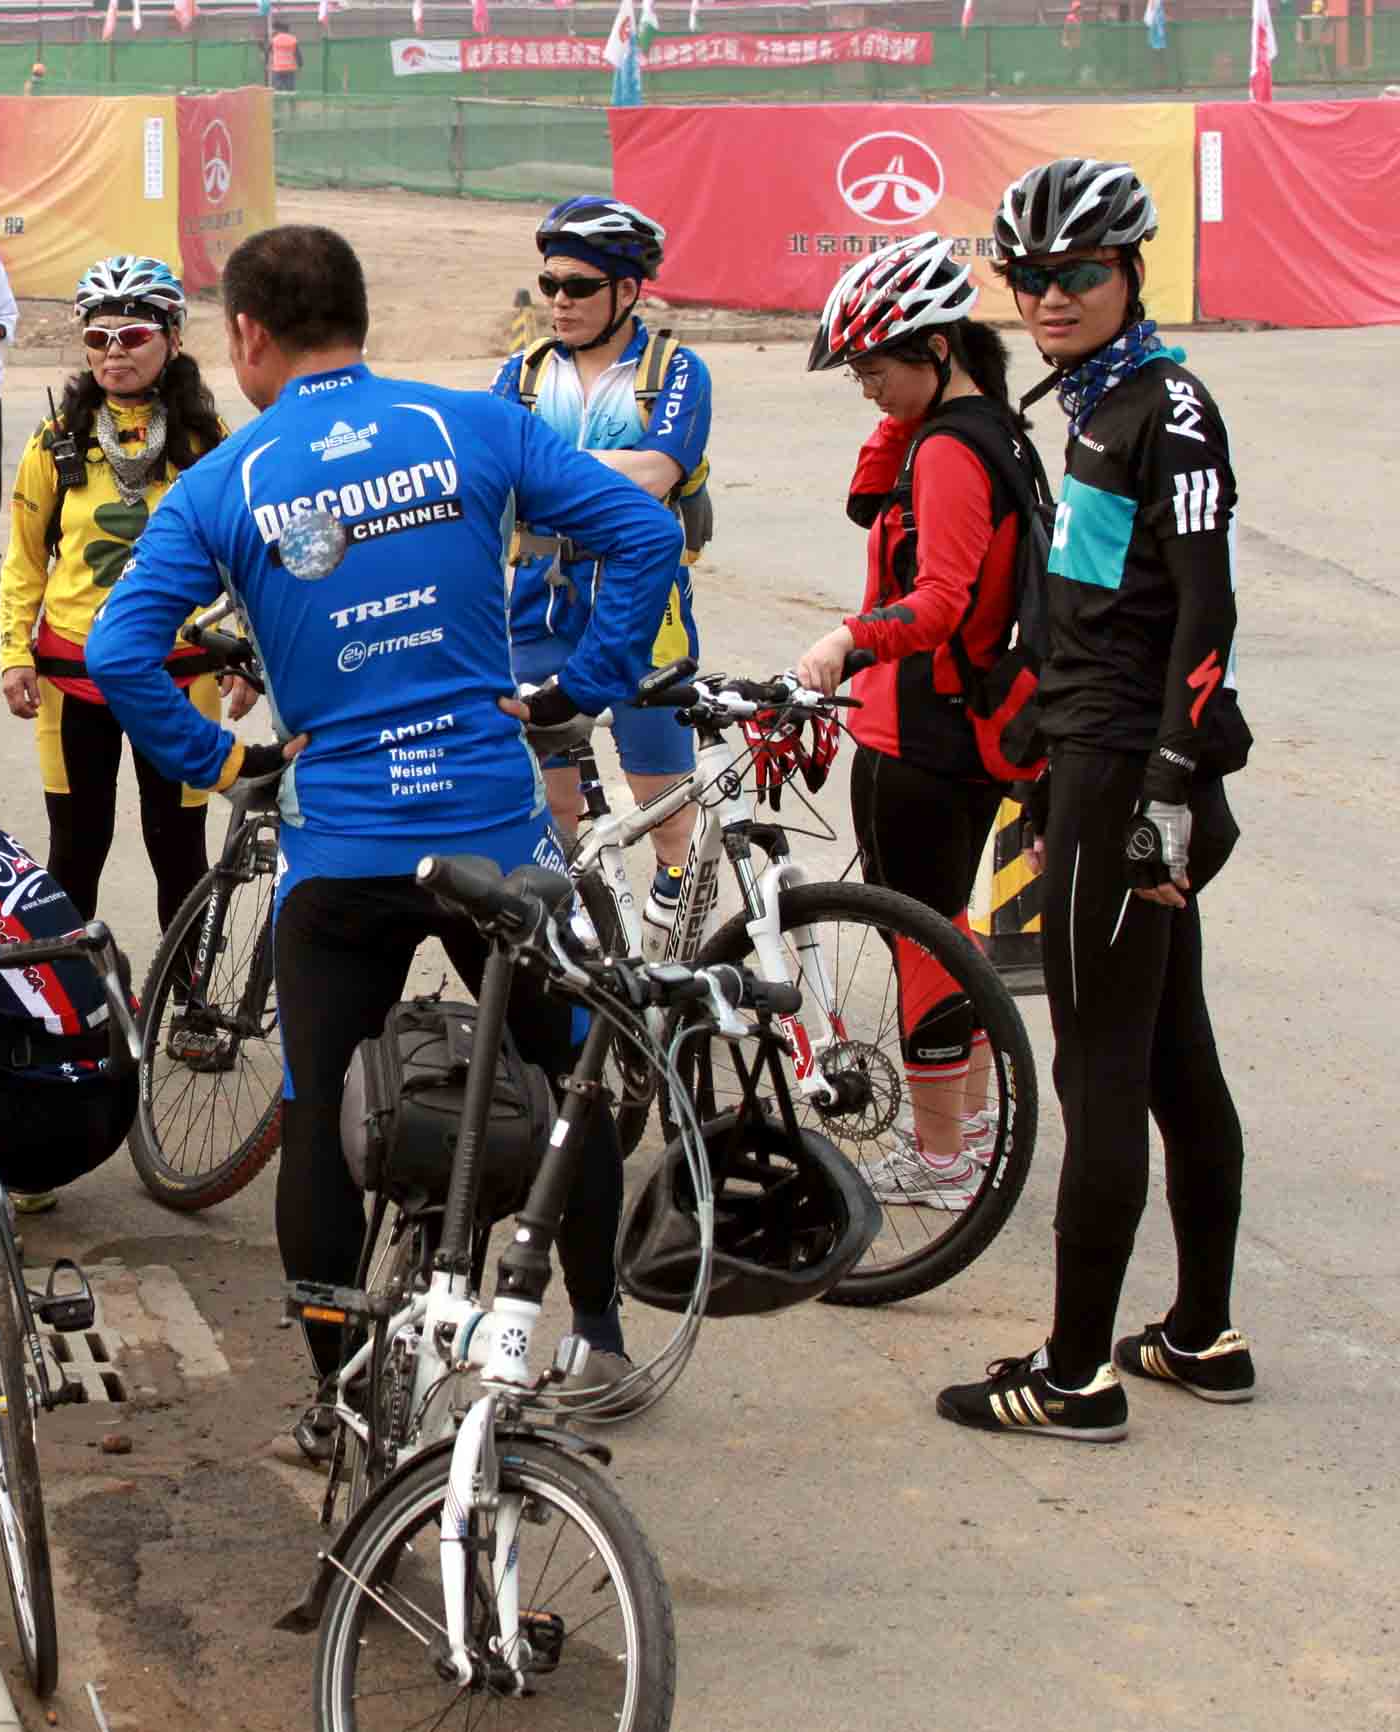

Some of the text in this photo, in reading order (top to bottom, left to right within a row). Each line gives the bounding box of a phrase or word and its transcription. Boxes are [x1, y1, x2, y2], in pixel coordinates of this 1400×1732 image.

[298, 378, 338, 396] AMD
[1165, 378, 1206, 442] SKY
[352, 503, 459, 540] CHANNEL
[329, 585, 437, 628] TREK
[368, 627, 443, 657] FITNESS
[380, 721, 433, 744] AMD
[388, 747, 444, 761] Thomas
[390, 762, 436, 779] Weisel
[391, 780, 453, 796] Partners
